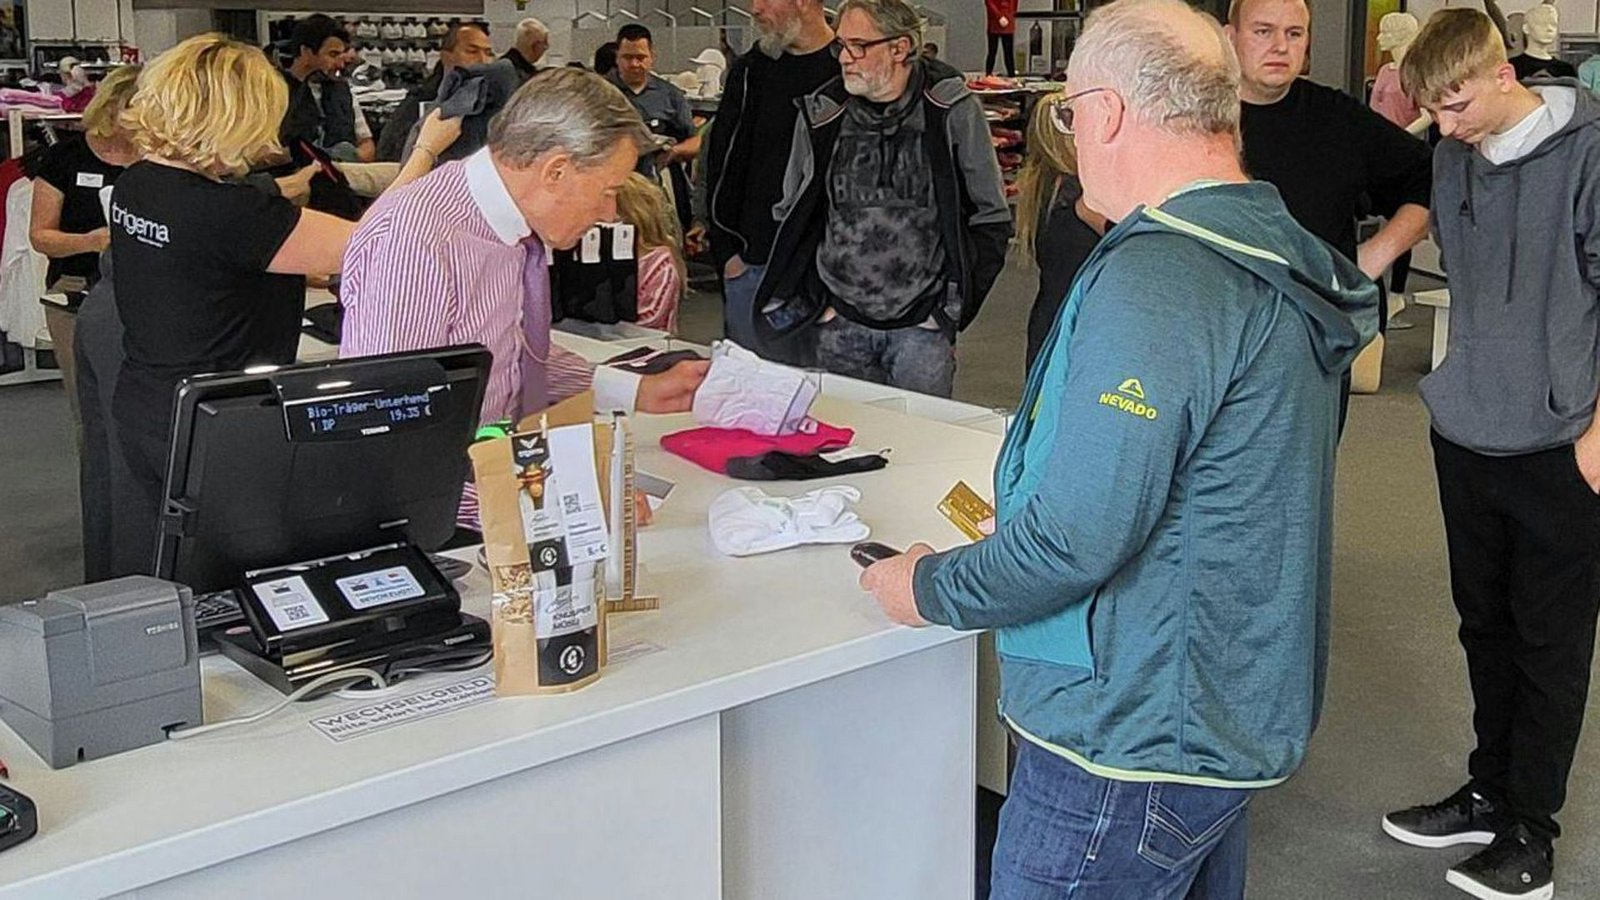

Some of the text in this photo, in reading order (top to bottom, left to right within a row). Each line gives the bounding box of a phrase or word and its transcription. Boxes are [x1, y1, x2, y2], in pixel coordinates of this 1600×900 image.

[112, 202, 170, 242] trigema
[1098, 392, 1158, 420] NEVADO
[319, 679, 489, 727] WECHSELGELD
[329, 717, 368, 735] Bitte
[370, 706, 415, 725] sofort
